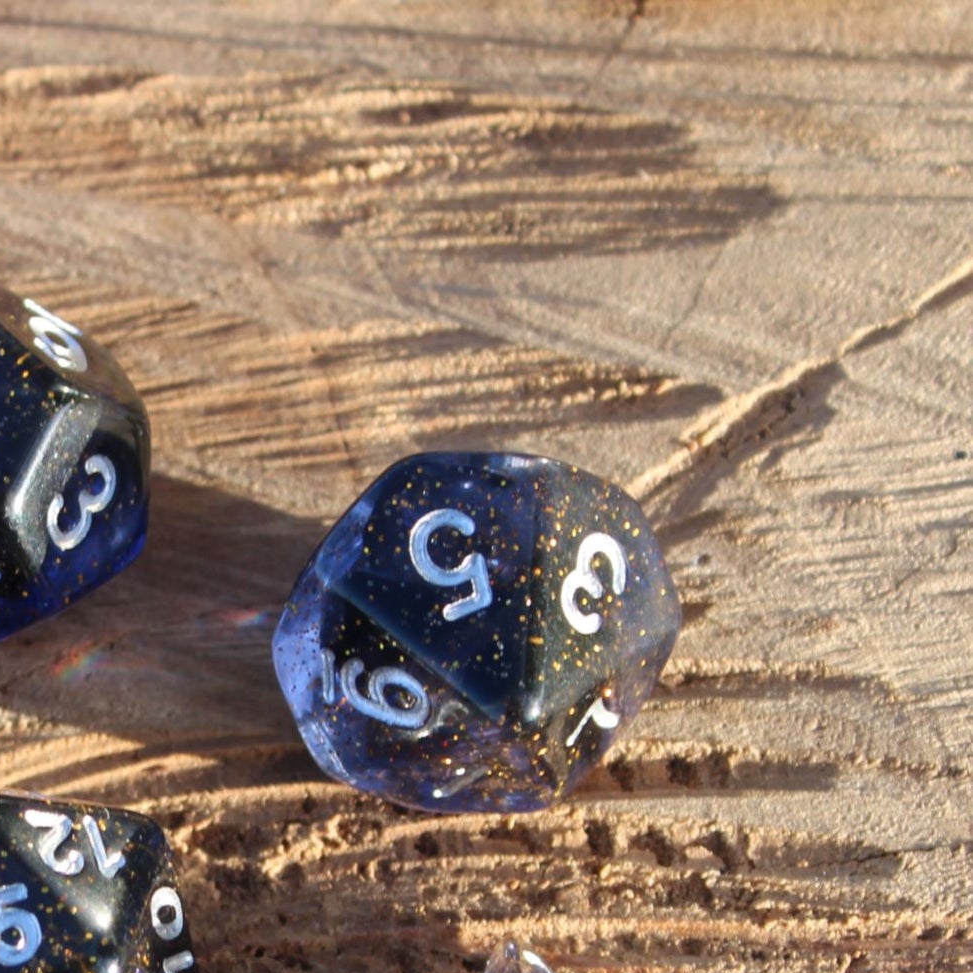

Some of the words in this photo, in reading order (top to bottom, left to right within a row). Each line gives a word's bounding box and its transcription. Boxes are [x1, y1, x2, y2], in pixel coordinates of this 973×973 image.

[46, 453, 117, 552] 3
[408, 508, 493, 622] 5
[560, 531, 627, 636] 3
[25, 808, 127, 880] 12
